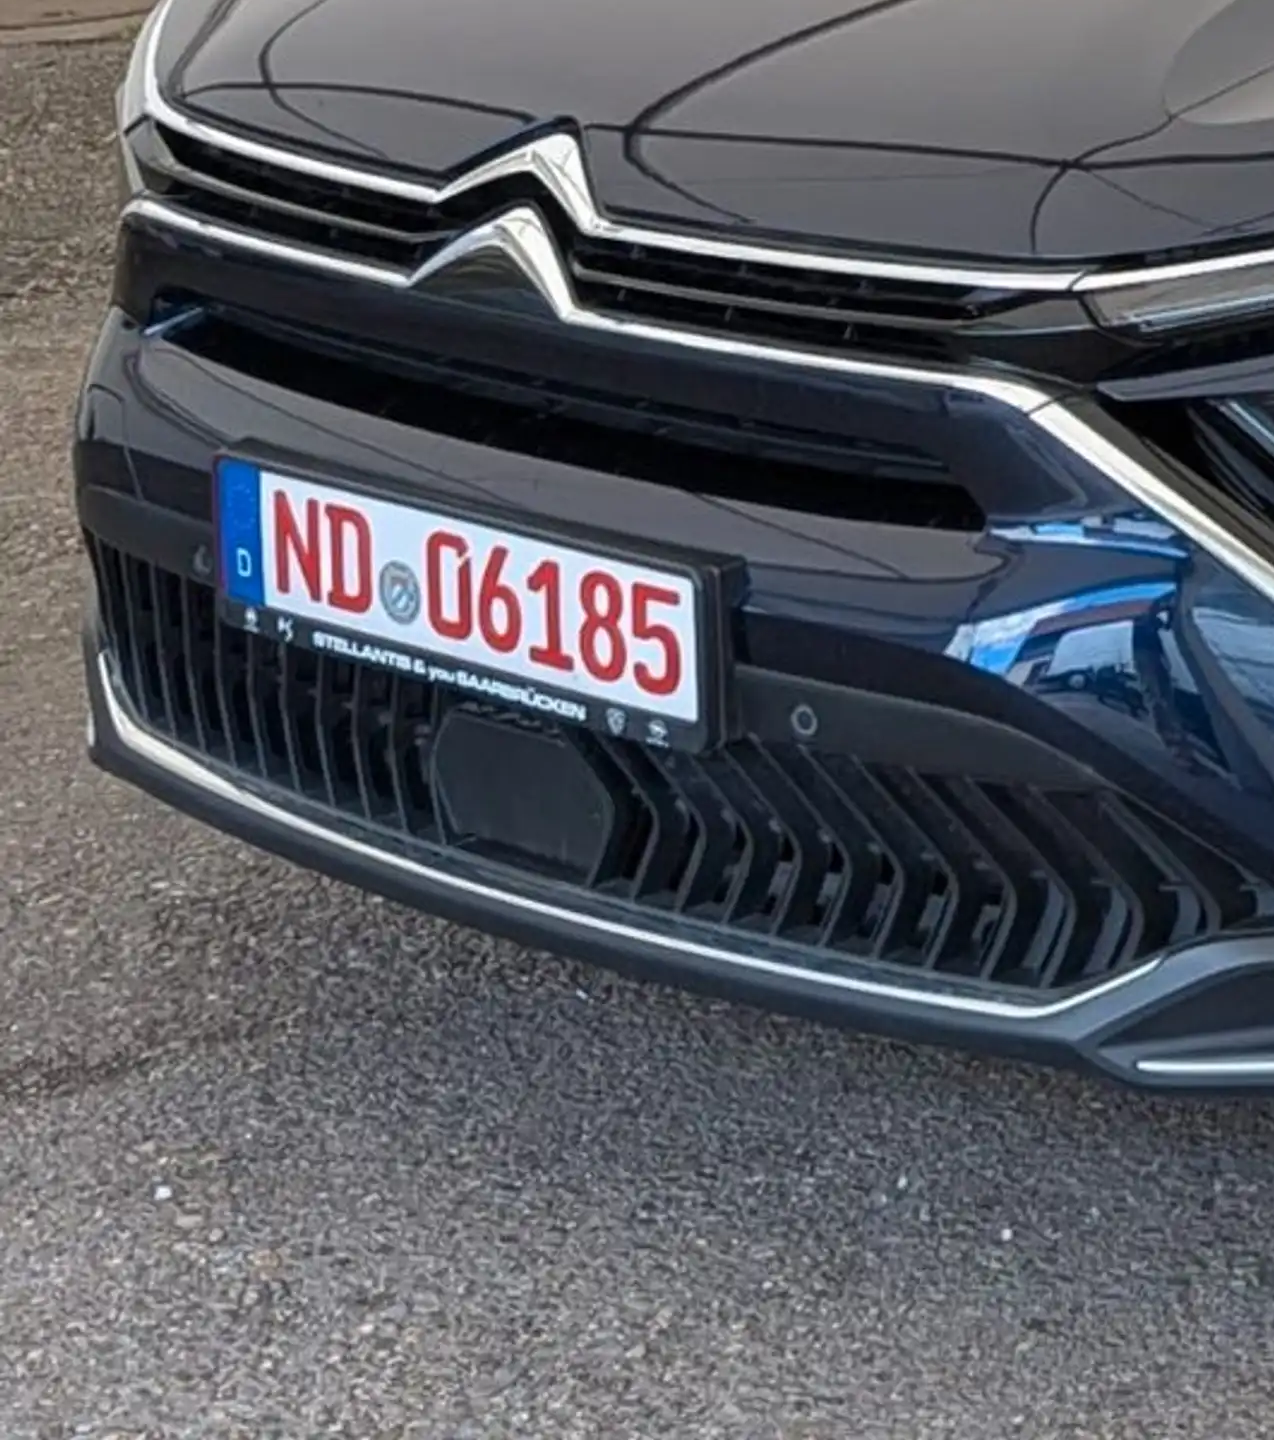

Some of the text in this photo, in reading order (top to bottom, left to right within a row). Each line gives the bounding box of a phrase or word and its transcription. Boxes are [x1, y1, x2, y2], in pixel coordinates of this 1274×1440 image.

[236, 547, 253, 577] D
[273, 489, 682, 696] ND 06185
[311, 631, 411, 672] STELLANTIS
